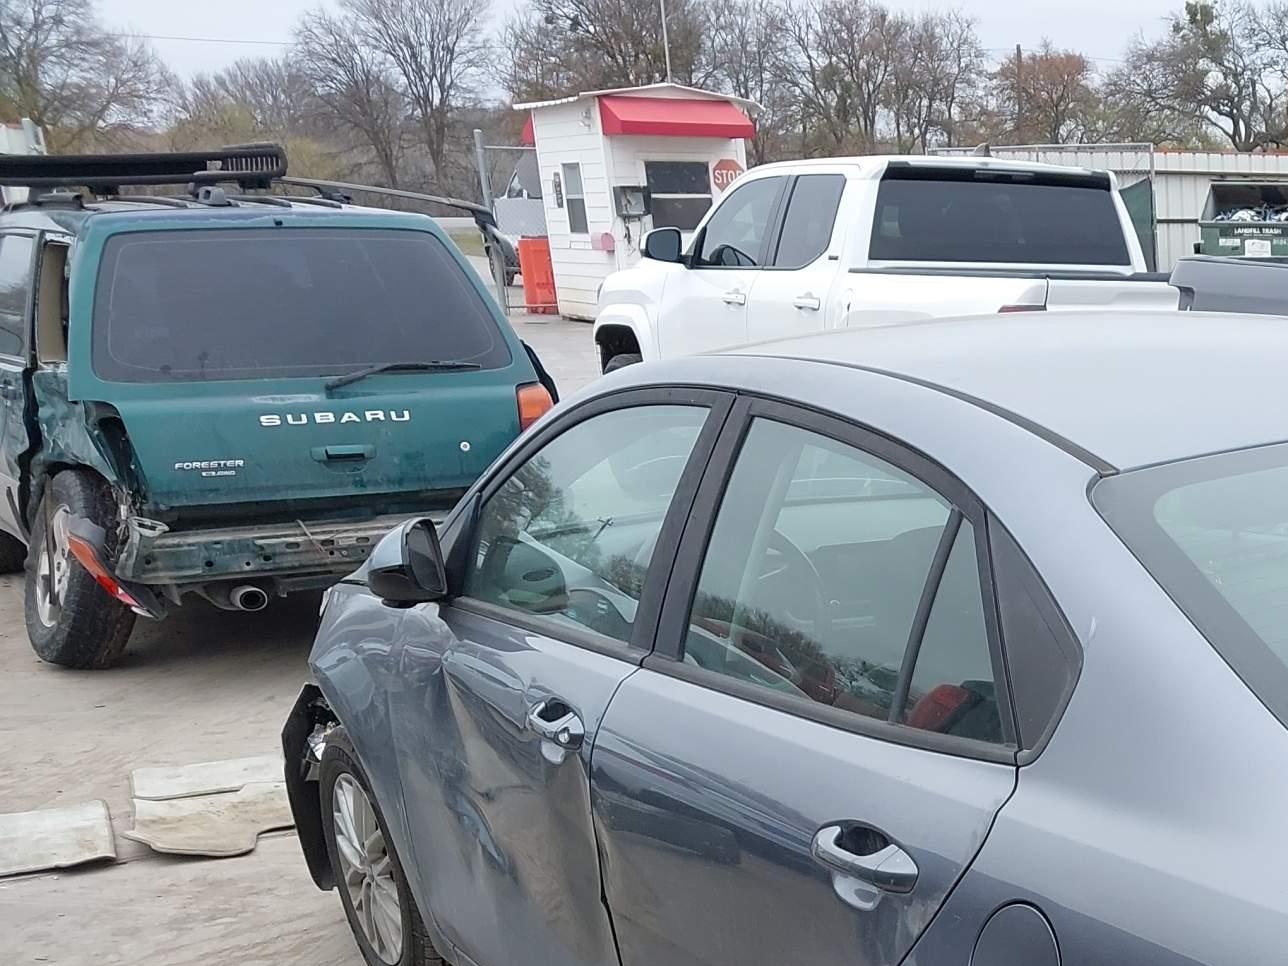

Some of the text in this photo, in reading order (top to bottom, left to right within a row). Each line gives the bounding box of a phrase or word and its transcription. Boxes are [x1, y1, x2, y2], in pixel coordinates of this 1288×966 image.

[1262, 227, 1282, 235] TRASH
[259, 410, 411, 426] SUBARU
[174, 460, 244, 470] FORESTER
